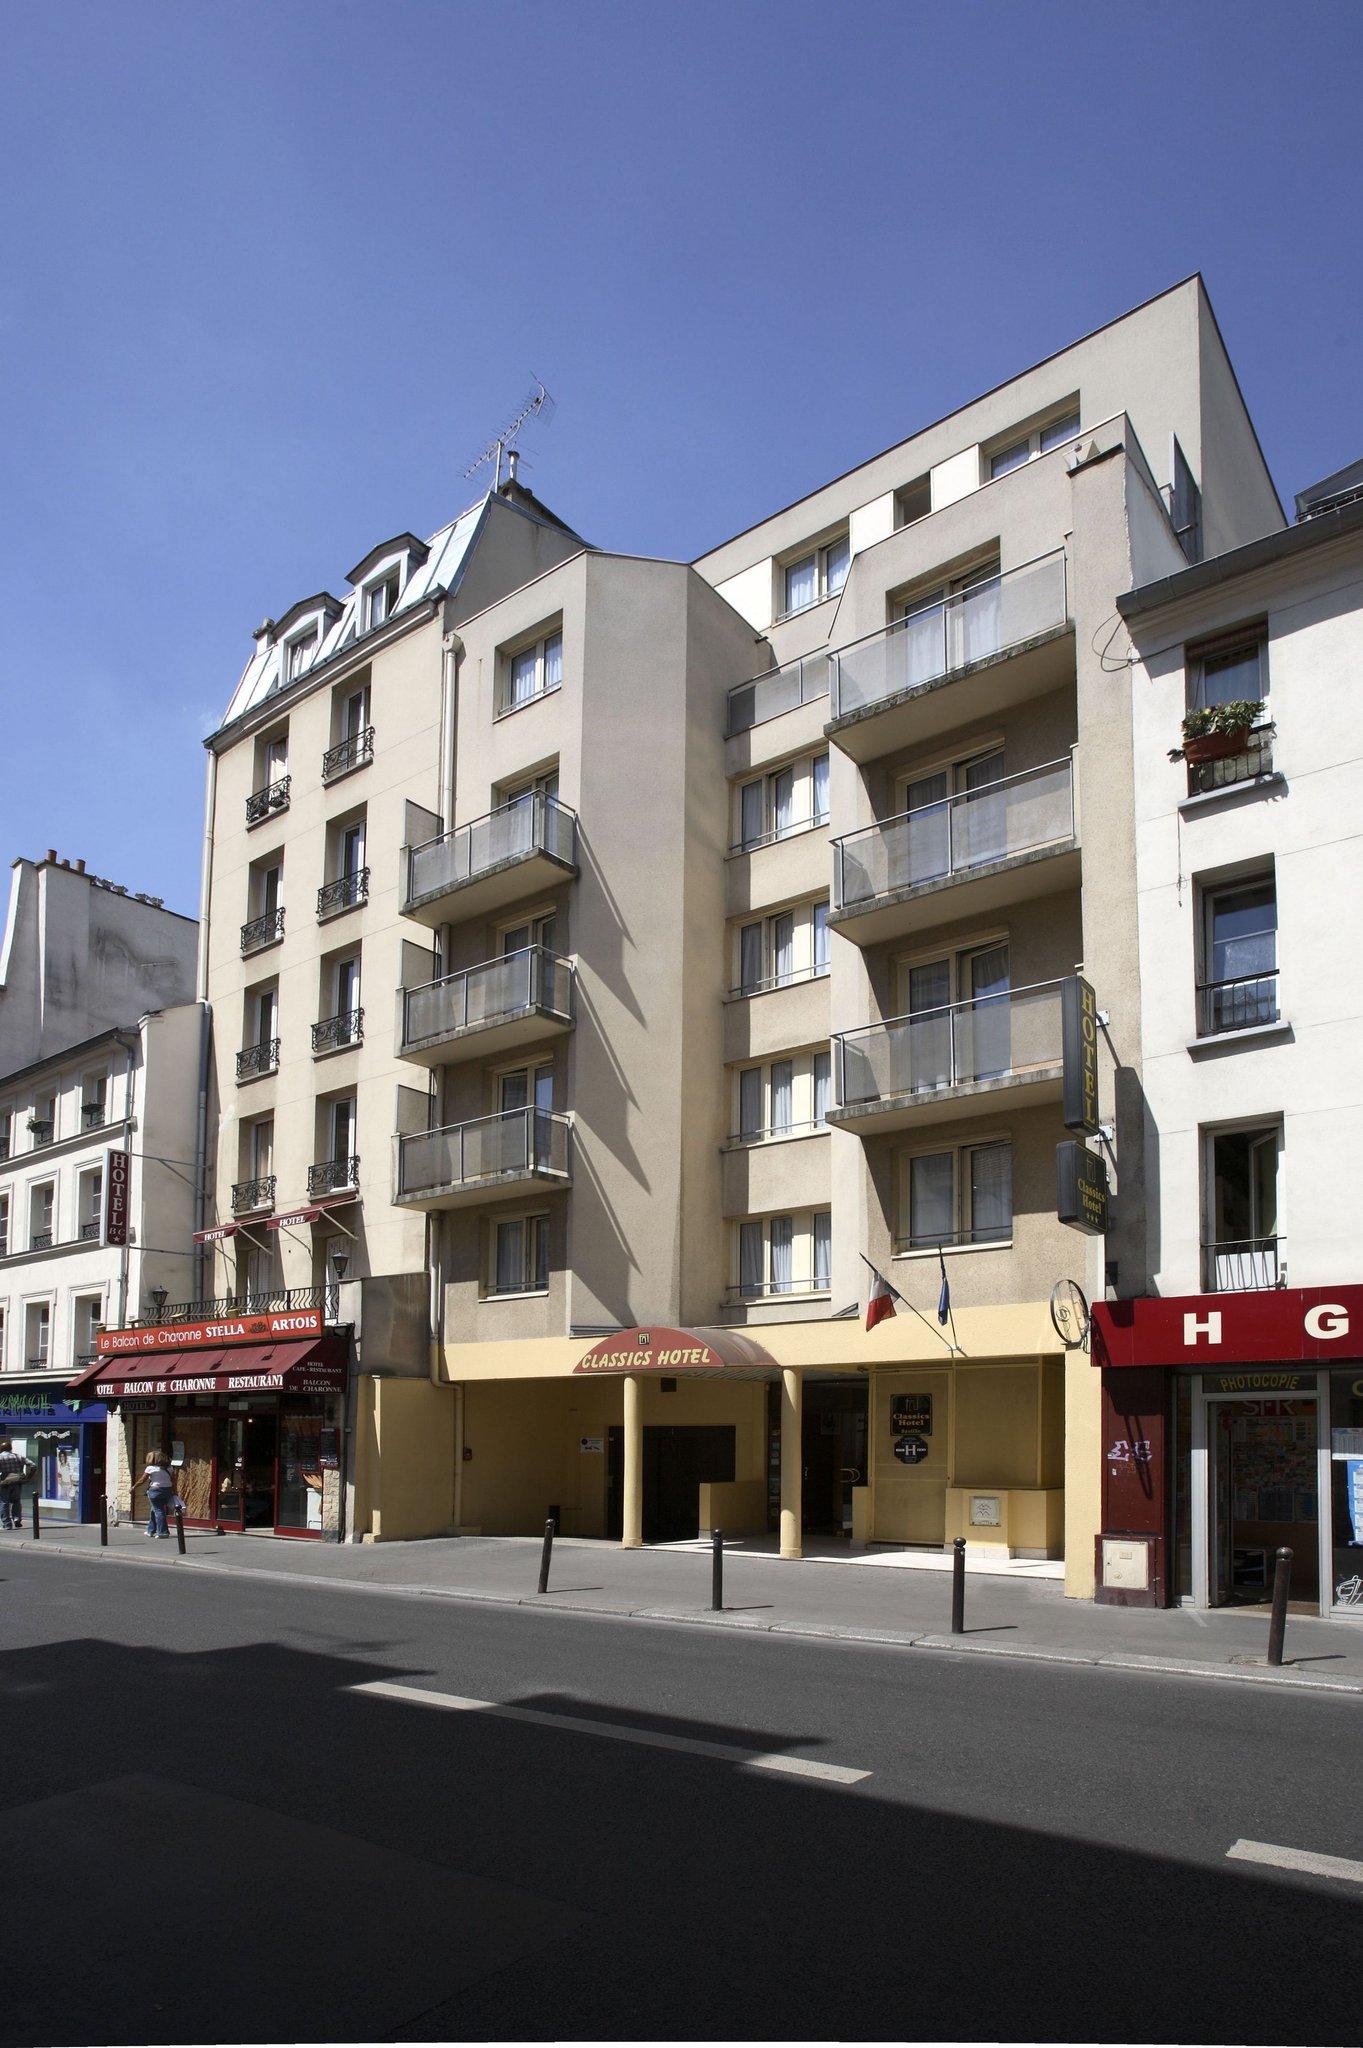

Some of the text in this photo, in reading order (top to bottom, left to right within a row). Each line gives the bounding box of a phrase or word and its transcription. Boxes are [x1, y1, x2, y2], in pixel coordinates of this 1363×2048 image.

[1081, 985, 1095, 1125] HOTEL
[111, 1153, 126, 1227] HOTEL
[1077, 1178, 1106, 1202] Classics
[1082, 1194, 1102, 1214] Hotel
[280, 1216, 305, 1227] HOTEL
[204, 1231, 226, 1241] HOTEL
[101, 1315, 318, 1349] Le Balcon de Charonne STELLA ARTOIS
[1183, 1303, 1350, 1346] H G
[582, 1348, 711, 1369] CLASSICS HOTEL
[123, 1382, 154, 1393] BALCON
[157, 1382, 167, 1392] DE
[170, 1378, 216, 1392] CHARONNE
[1220, 1374, 1300, 1392] PHOTOCOPIE
[905, 1444, 916, 1456] H
